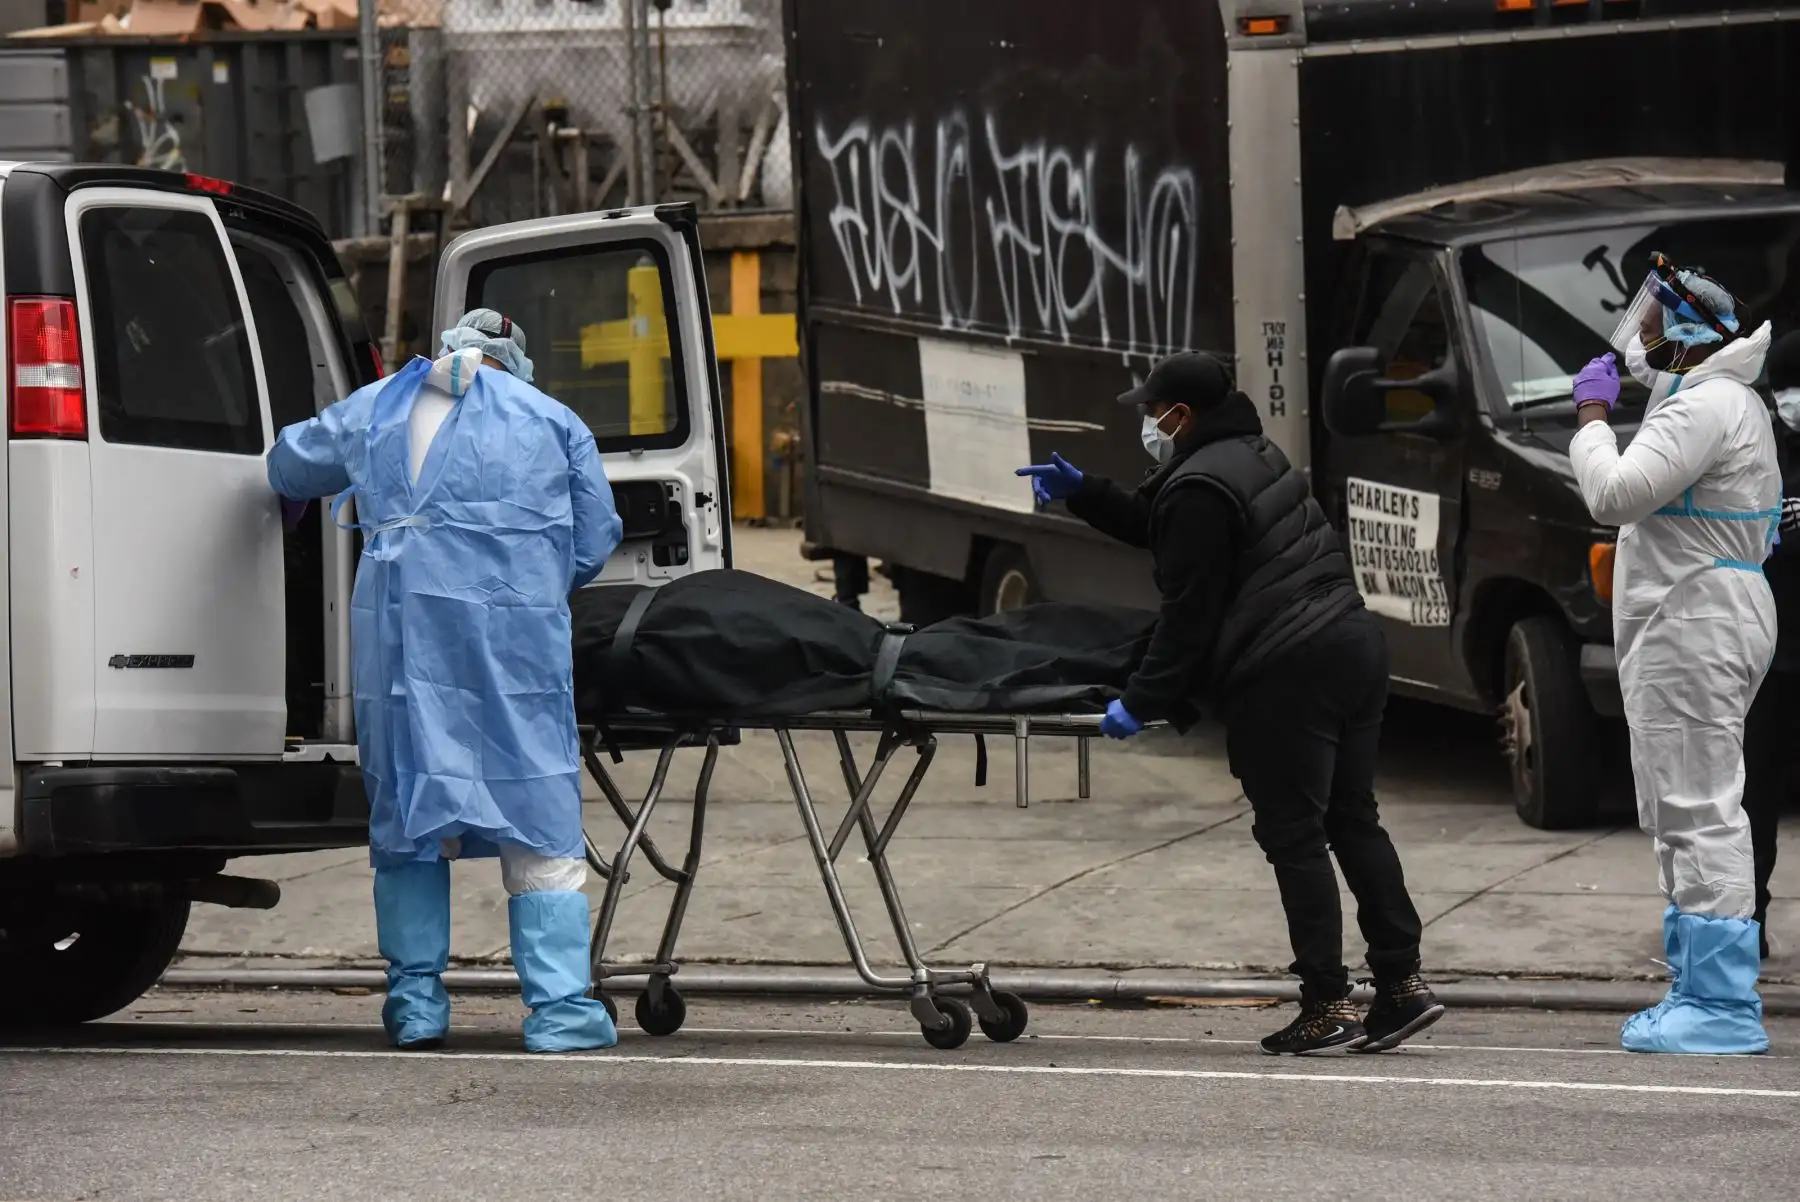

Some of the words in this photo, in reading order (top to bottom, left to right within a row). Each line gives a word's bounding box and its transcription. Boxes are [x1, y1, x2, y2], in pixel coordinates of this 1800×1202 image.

[1354, 544, 1439, 574] 13478560216
[1386, 573, 1428, 599] MACON
[1428, 577, 1448, 601] ST
